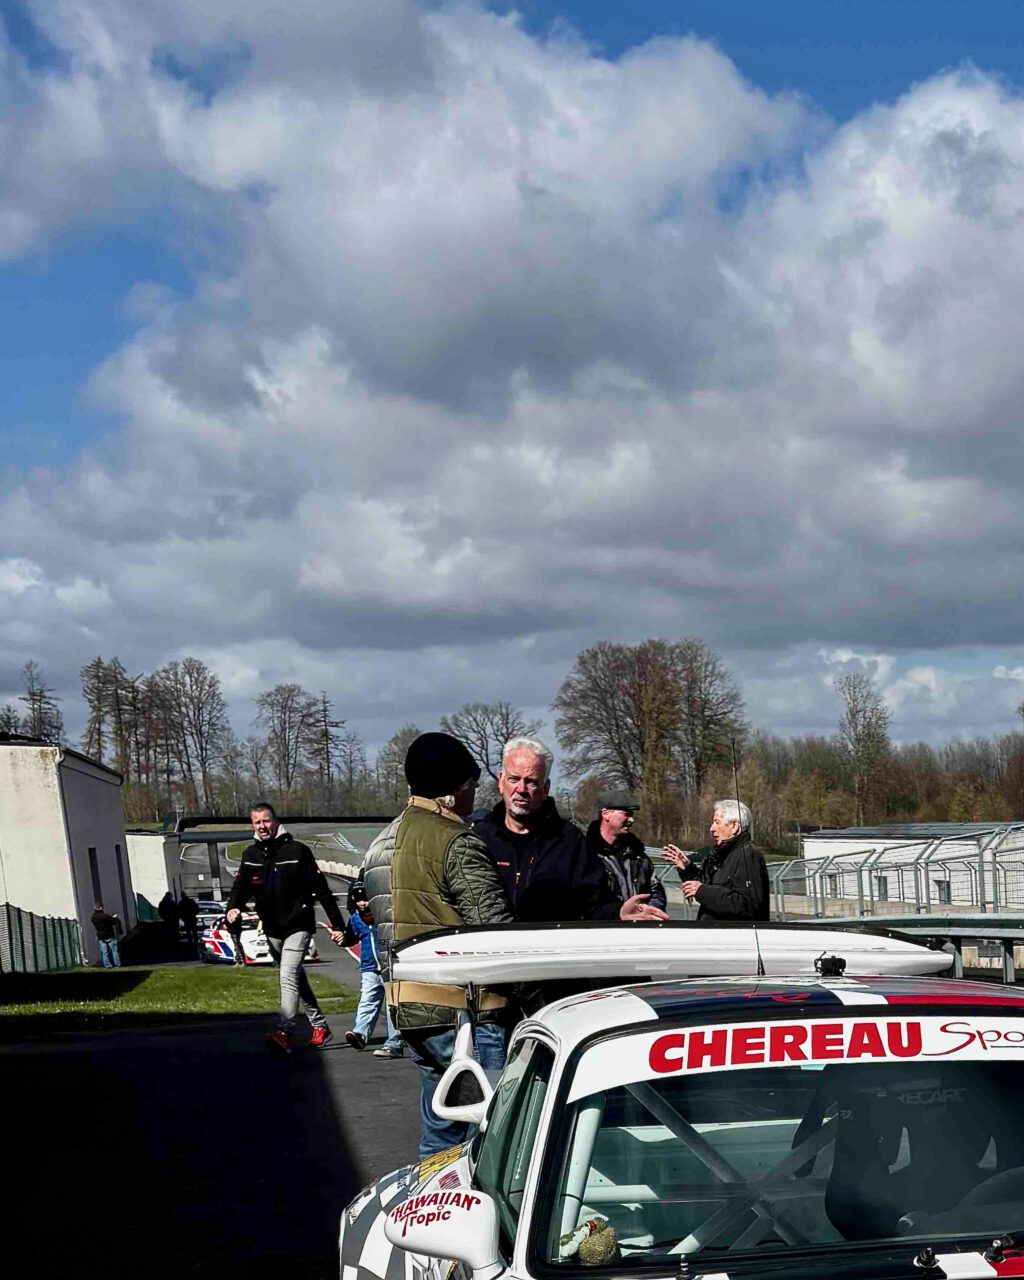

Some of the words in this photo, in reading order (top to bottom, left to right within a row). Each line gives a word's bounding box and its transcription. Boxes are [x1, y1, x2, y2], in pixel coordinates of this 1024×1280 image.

[649, 1021, 922, 1074] CHEREAU
[390, 1192, 481, 1224] HAWAIIAN
[399, 1208, 452, 1238] Tropic
